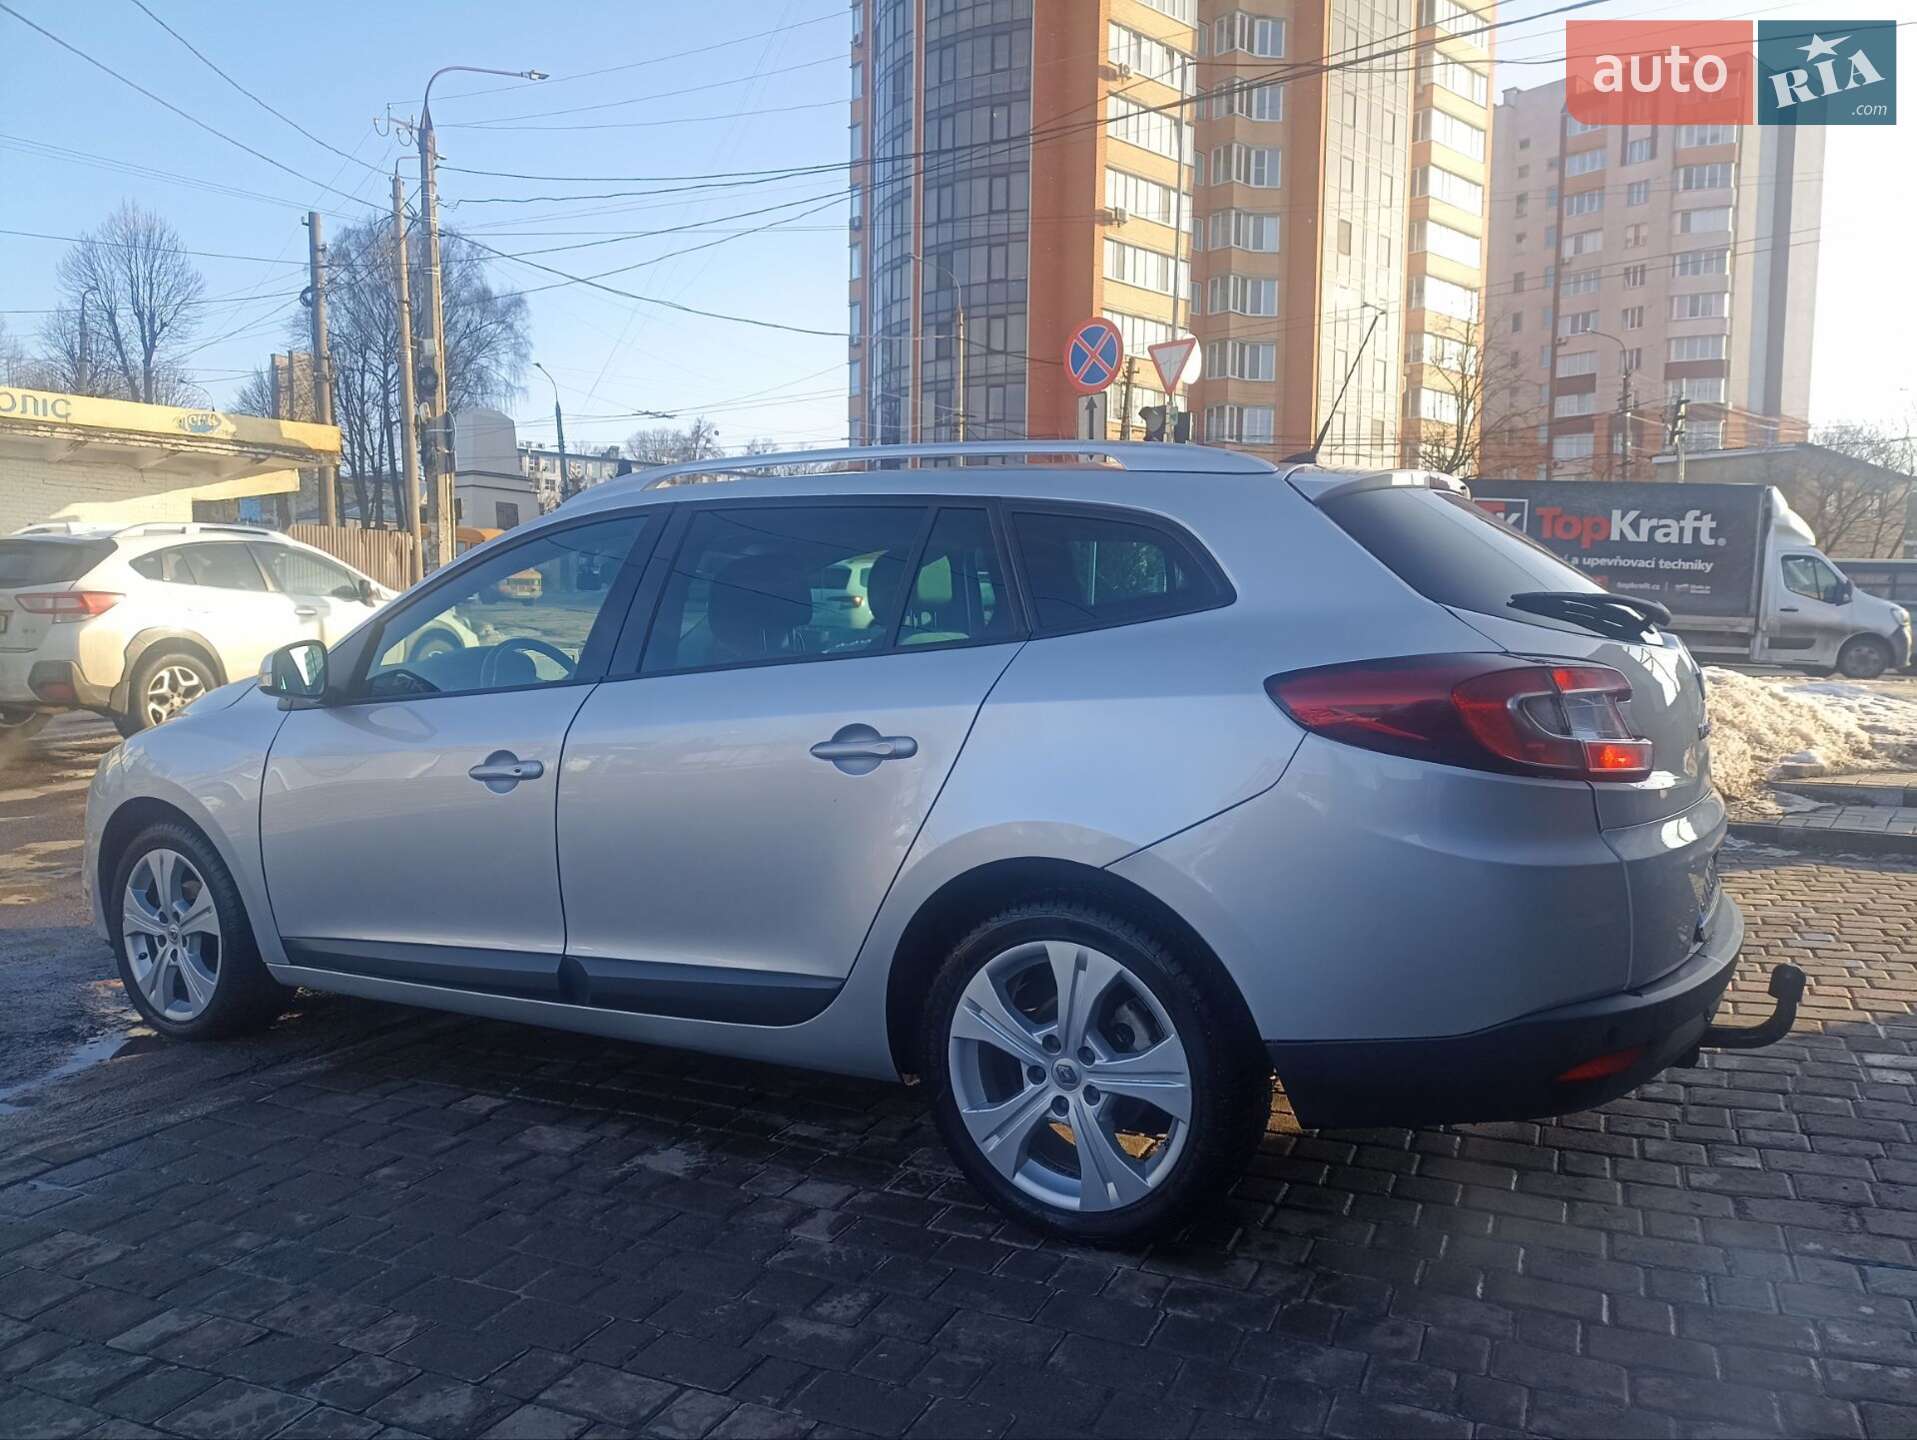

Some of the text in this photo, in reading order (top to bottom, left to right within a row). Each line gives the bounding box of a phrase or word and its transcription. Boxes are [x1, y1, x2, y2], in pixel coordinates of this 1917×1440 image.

[1571, 556, 1579, 565] a
[1582, 556, 1655, 569] upevňovací
[1658, 558, 1714, 573] techniky
